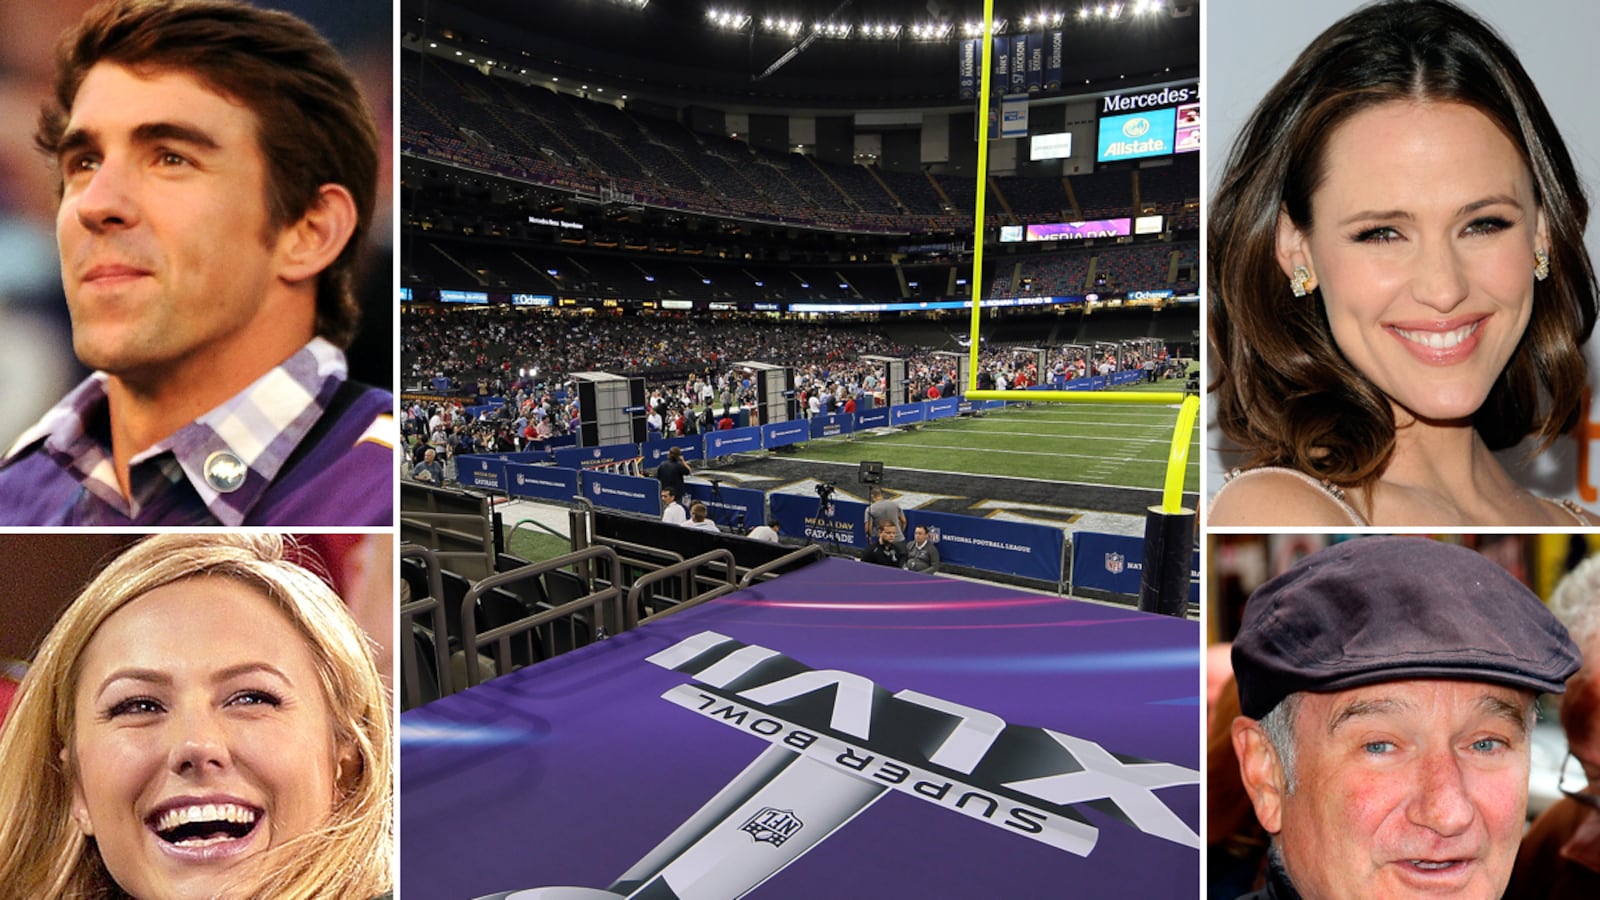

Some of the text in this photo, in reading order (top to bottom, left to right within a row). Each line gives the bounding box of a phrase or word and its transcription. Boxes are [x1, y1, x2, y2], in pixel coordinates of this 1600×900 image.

[964, 43, 974, 77] MANNING
[1016, 41, 1025, 72] JACKSON
[1033, 48, 1041, 71] DIXON
[1053, 32, 1062, 69] ROBINSON
[804, 516, 855, 530] MEDA DAY
[942, 534, 1031, 553] NATIONAL FOOTBALL LEAGUE
[645, 630, 1200, 850] XLVII
[698, 693, 1047, 834] SUPER BOWL
[761, 811, 799, 835] NFL
